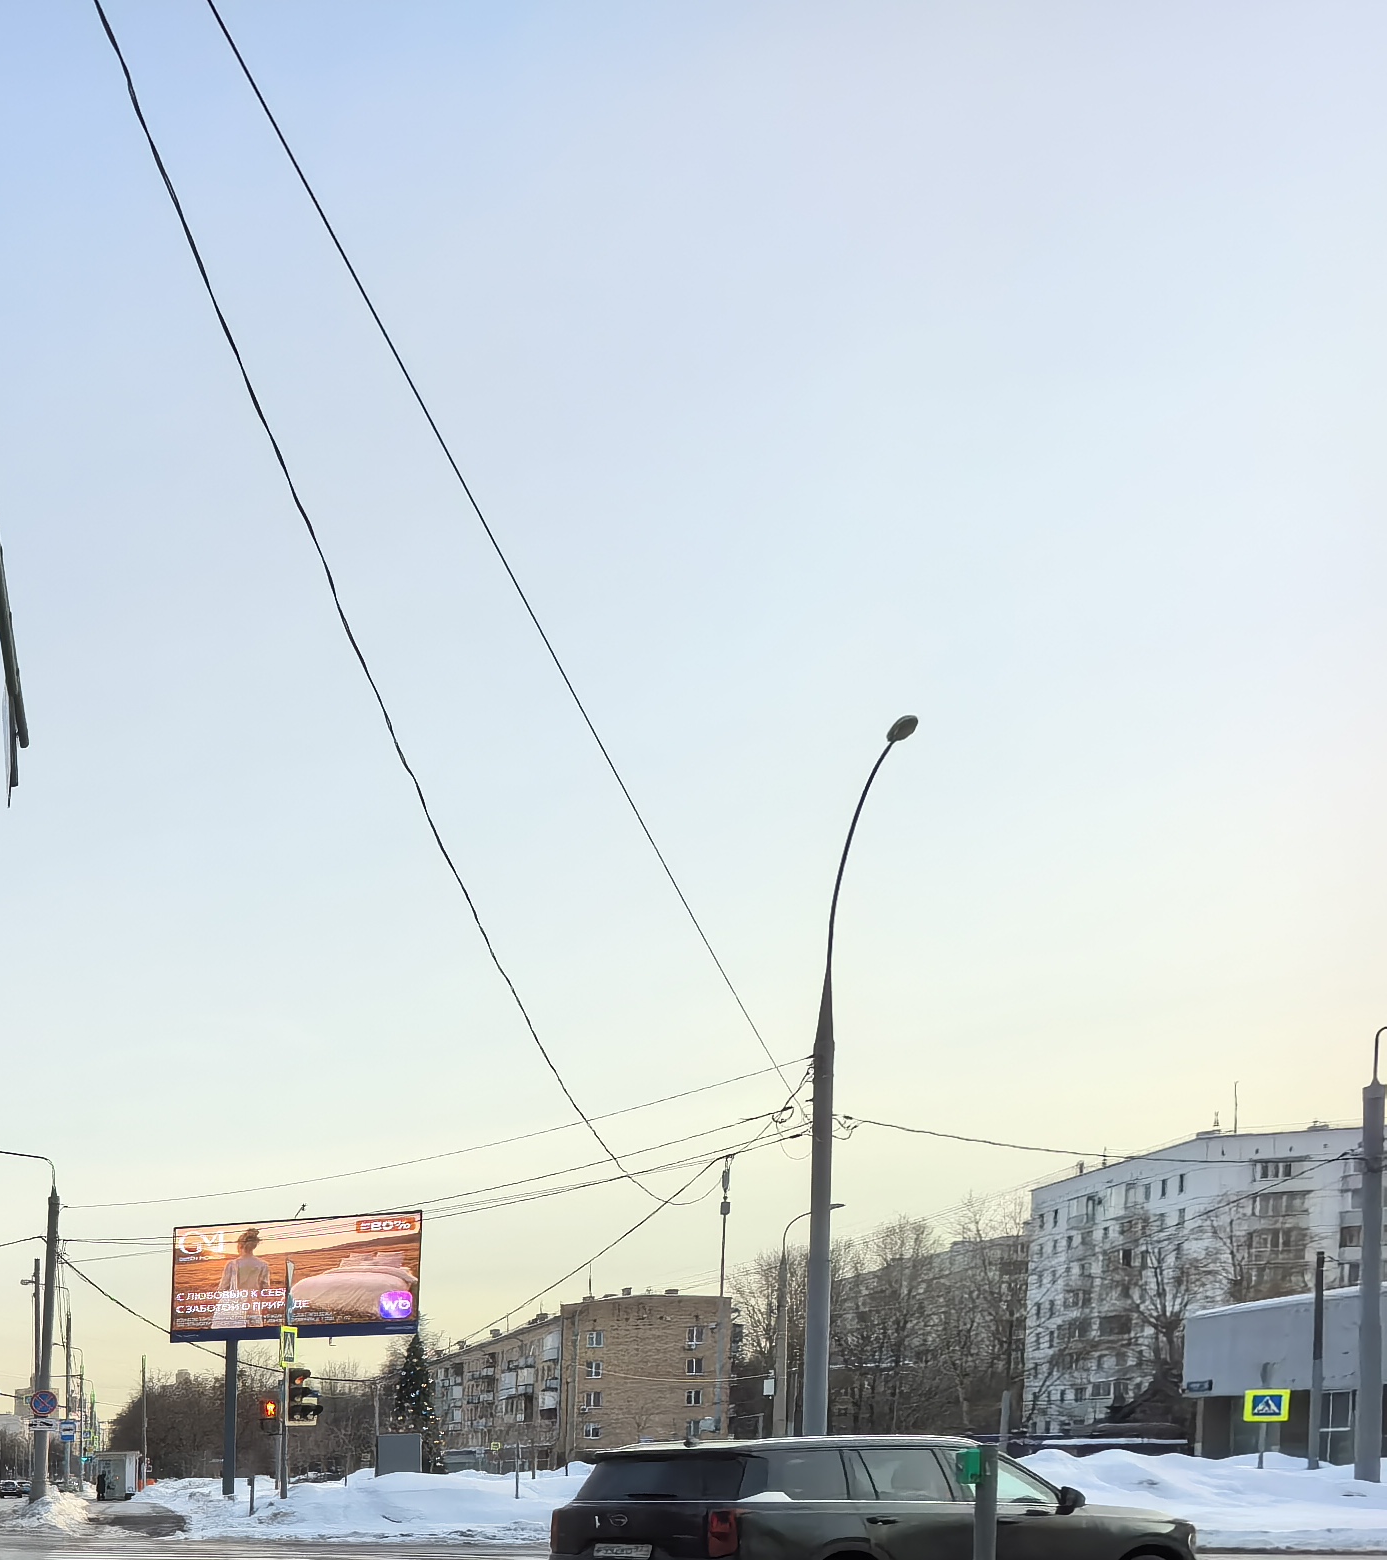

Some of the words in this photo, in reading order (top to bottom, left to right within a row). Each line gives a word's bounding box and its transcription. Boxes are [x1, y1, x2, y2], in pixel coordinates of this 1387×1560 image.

[186, 1289, 248, 1301] ЛЮБОВЬЮ
[251, 1289, 258, 1298] К
[186, 1301, 240, 1313] ЗАБОТОЙ
[242, 1302, 250, 1310] О
[252, 1299, 310, 1311] ПРИРДЕ
